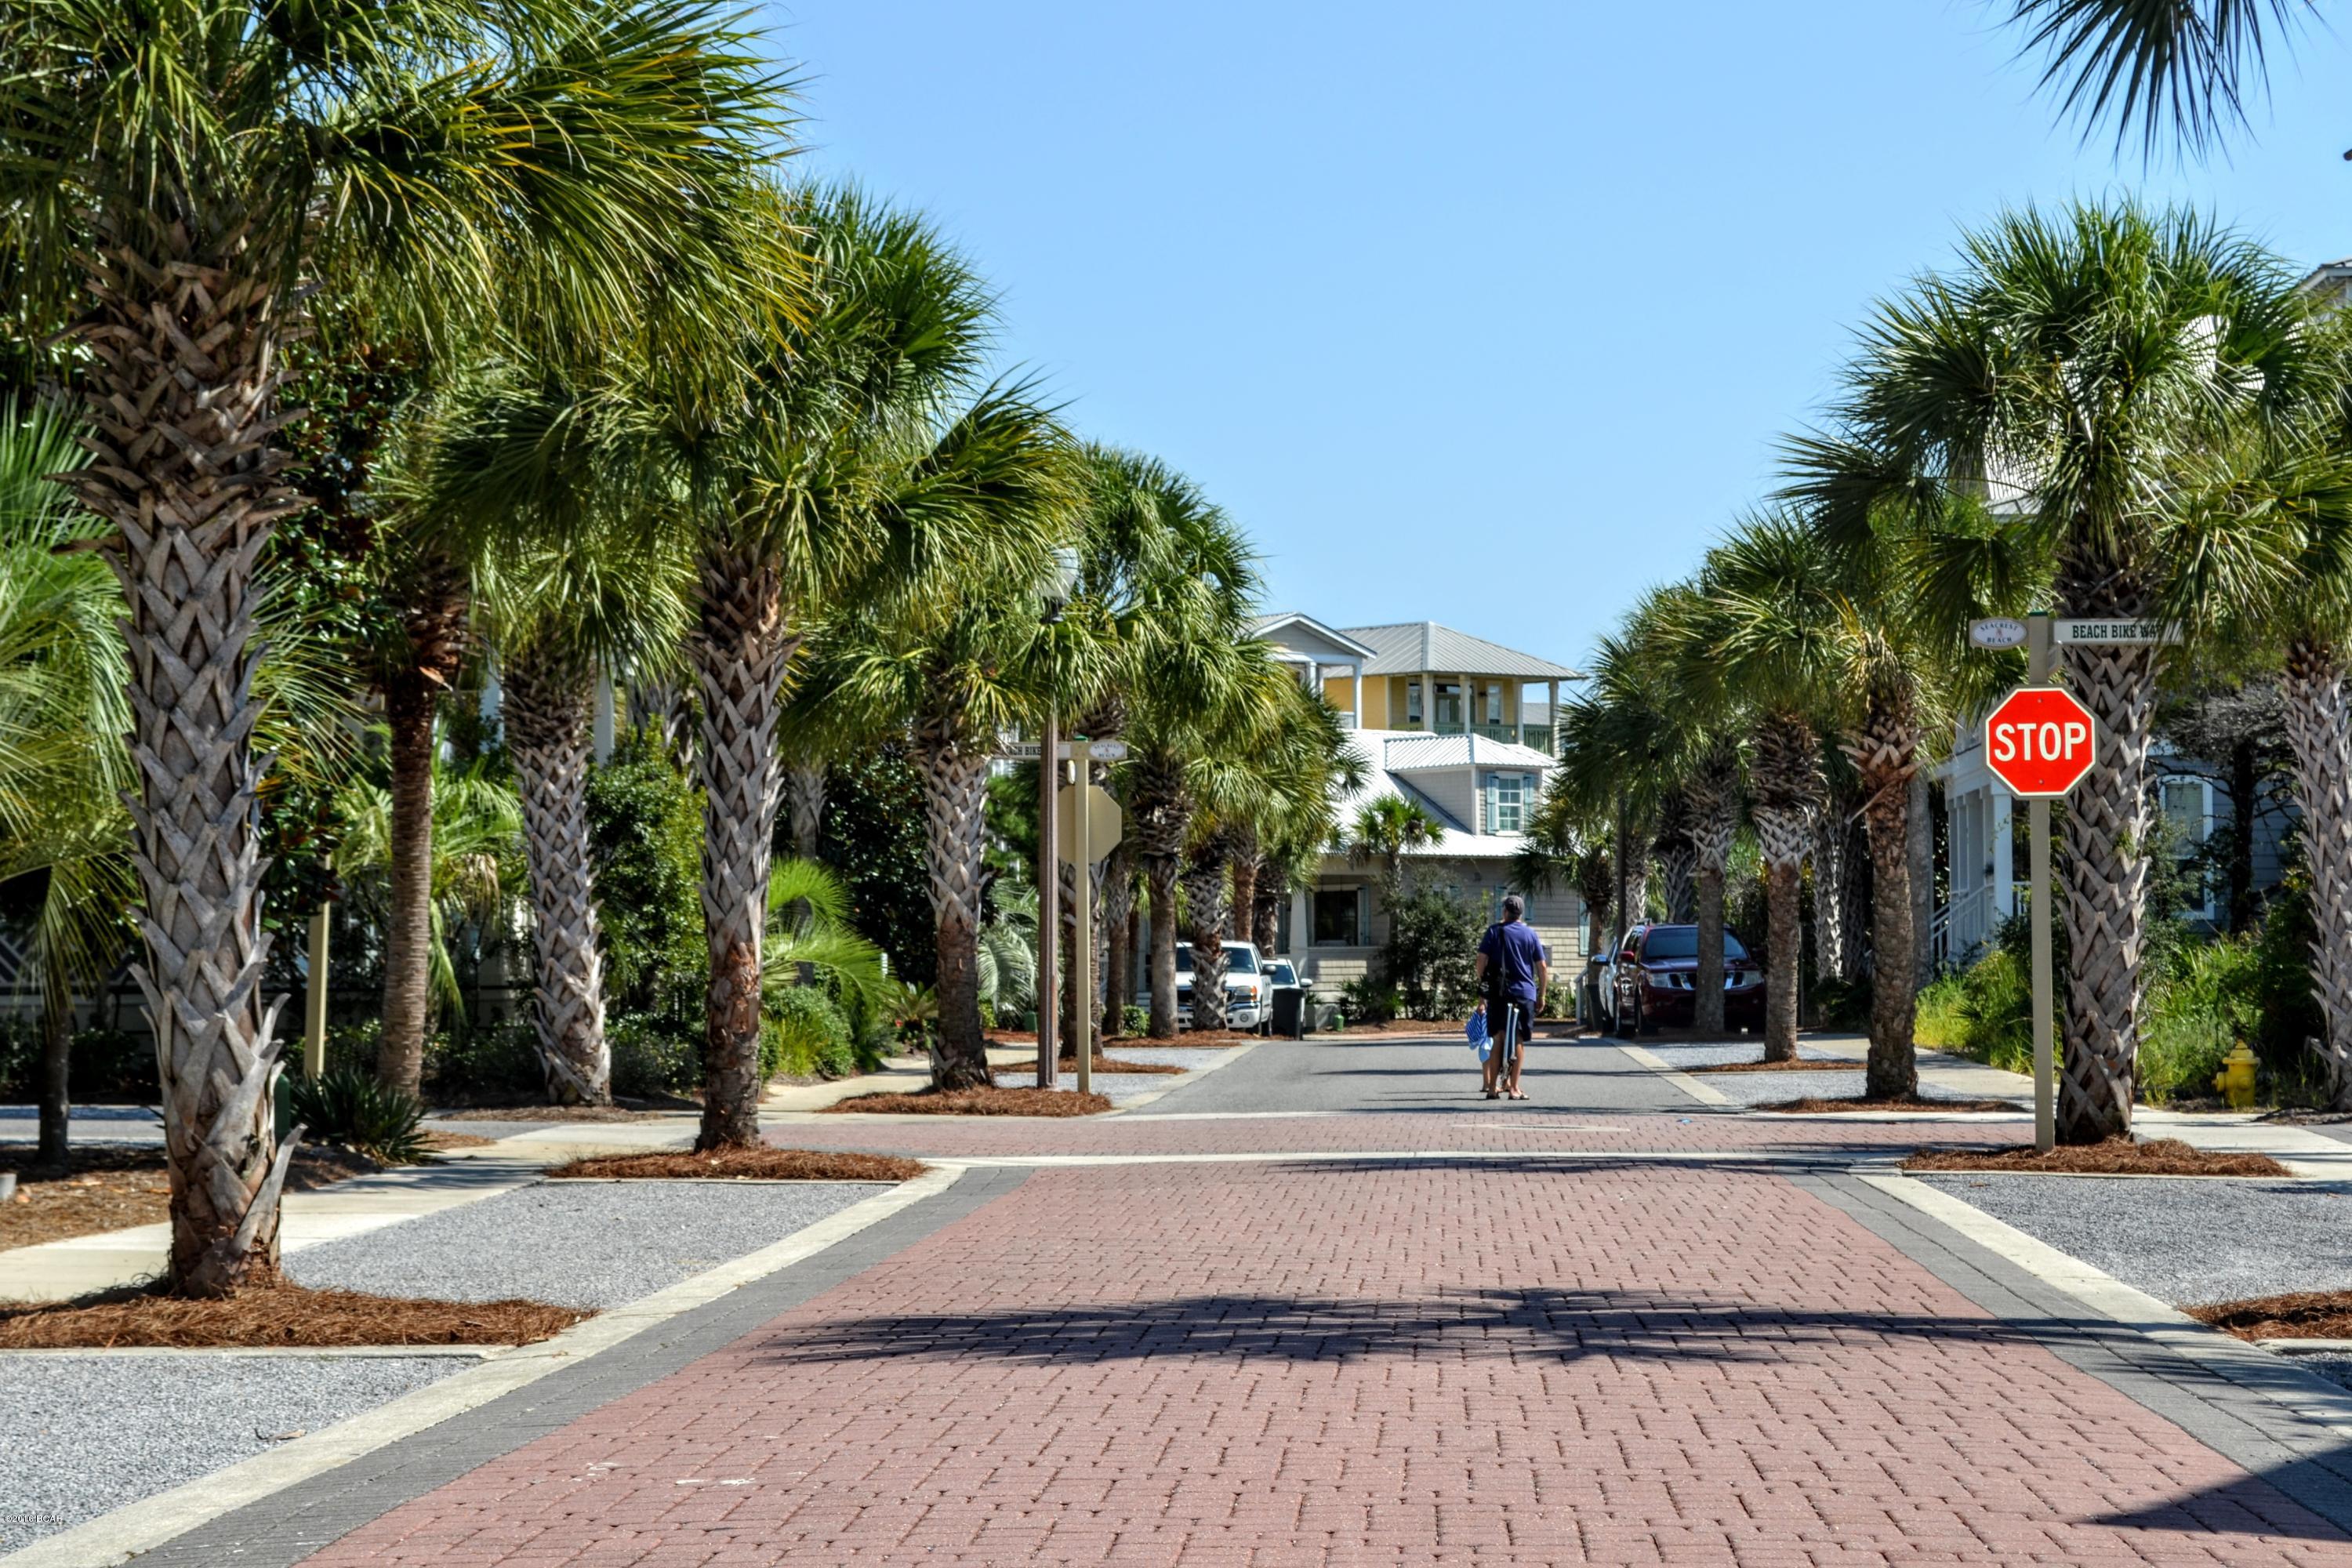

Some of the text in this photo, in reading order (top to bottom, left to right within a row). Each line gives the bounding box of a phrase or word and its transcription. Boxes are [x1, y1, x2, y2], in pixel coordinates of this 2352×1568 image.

[1980, 622, 2018, 631] SEACREST
[2072, 624, 2107, 638] BEACH
[2112, 624, 2136, 638] BIKE
[1994, 722, 2087, 761] STOP
[1025, 746, 1041, 756] BIKE
